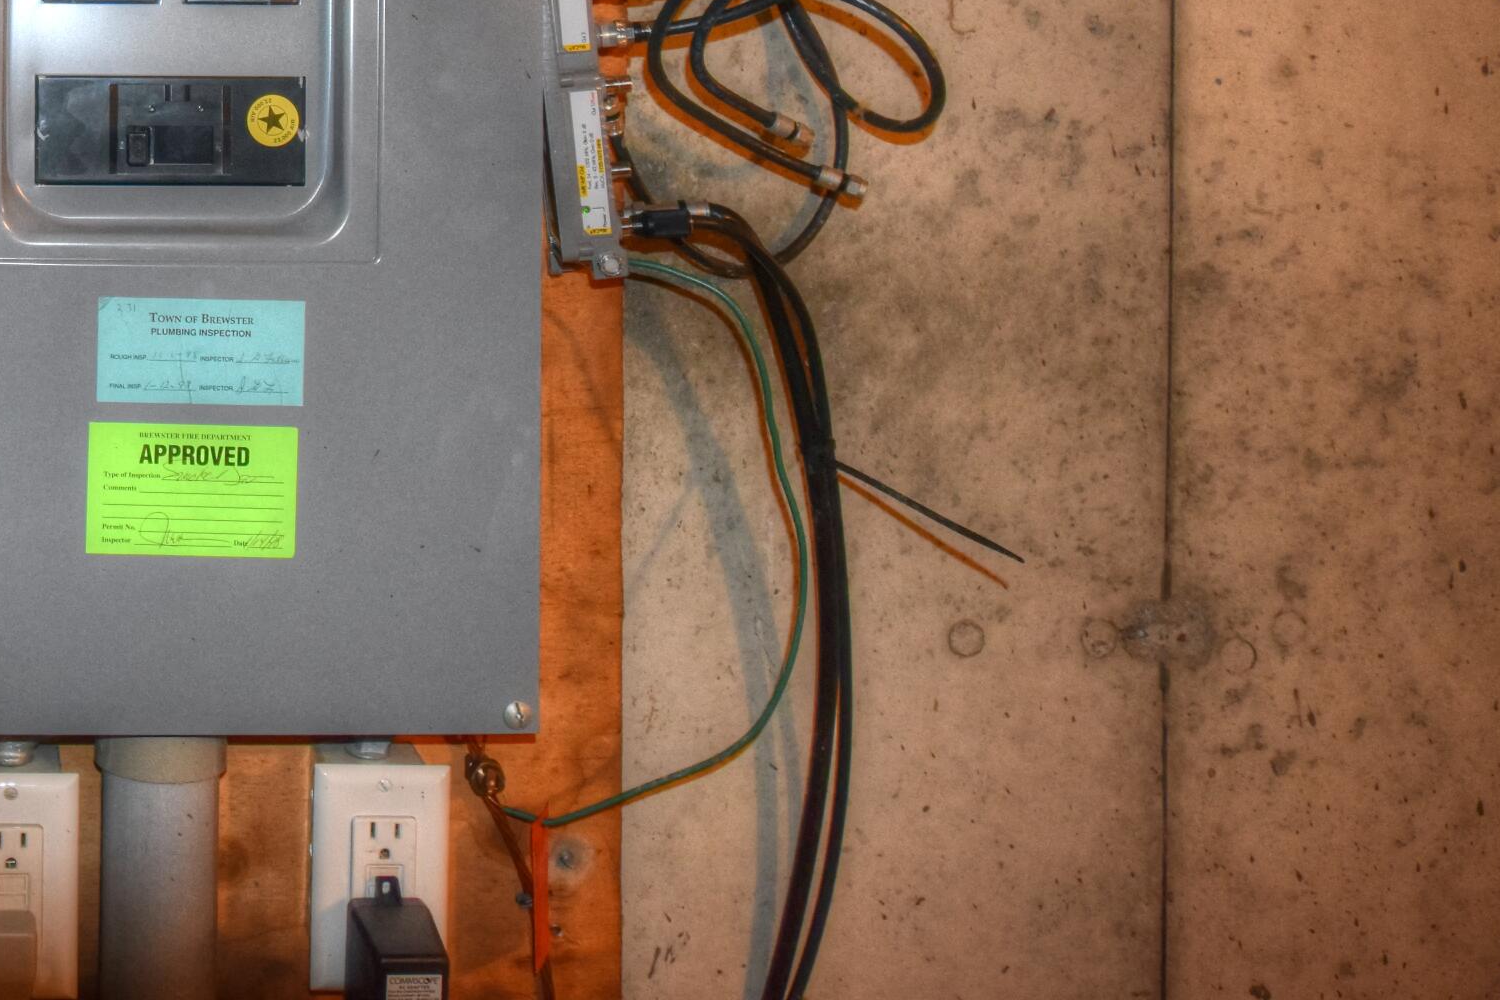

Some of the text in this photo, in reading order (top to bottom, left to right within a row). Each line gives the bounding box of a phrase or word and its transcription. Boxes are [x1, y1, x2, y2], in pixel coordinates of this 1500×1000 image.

[148, 312, 254, 325] TOWN OF BREWSTER
[151, 328, 252, 338] PLUMBING INSPECTION
[139, 431, 181, 439] BREWSTER
[201, 433, 252, 441] DEPARTMENT
[139, 444, 250, 467] APPROVED
[103, 471, 118, 479] Type
[128, 472, 161, 480] Inspection
[102, 523, 123, 531] Permit
[101, 536, 132, 544] Inspector
